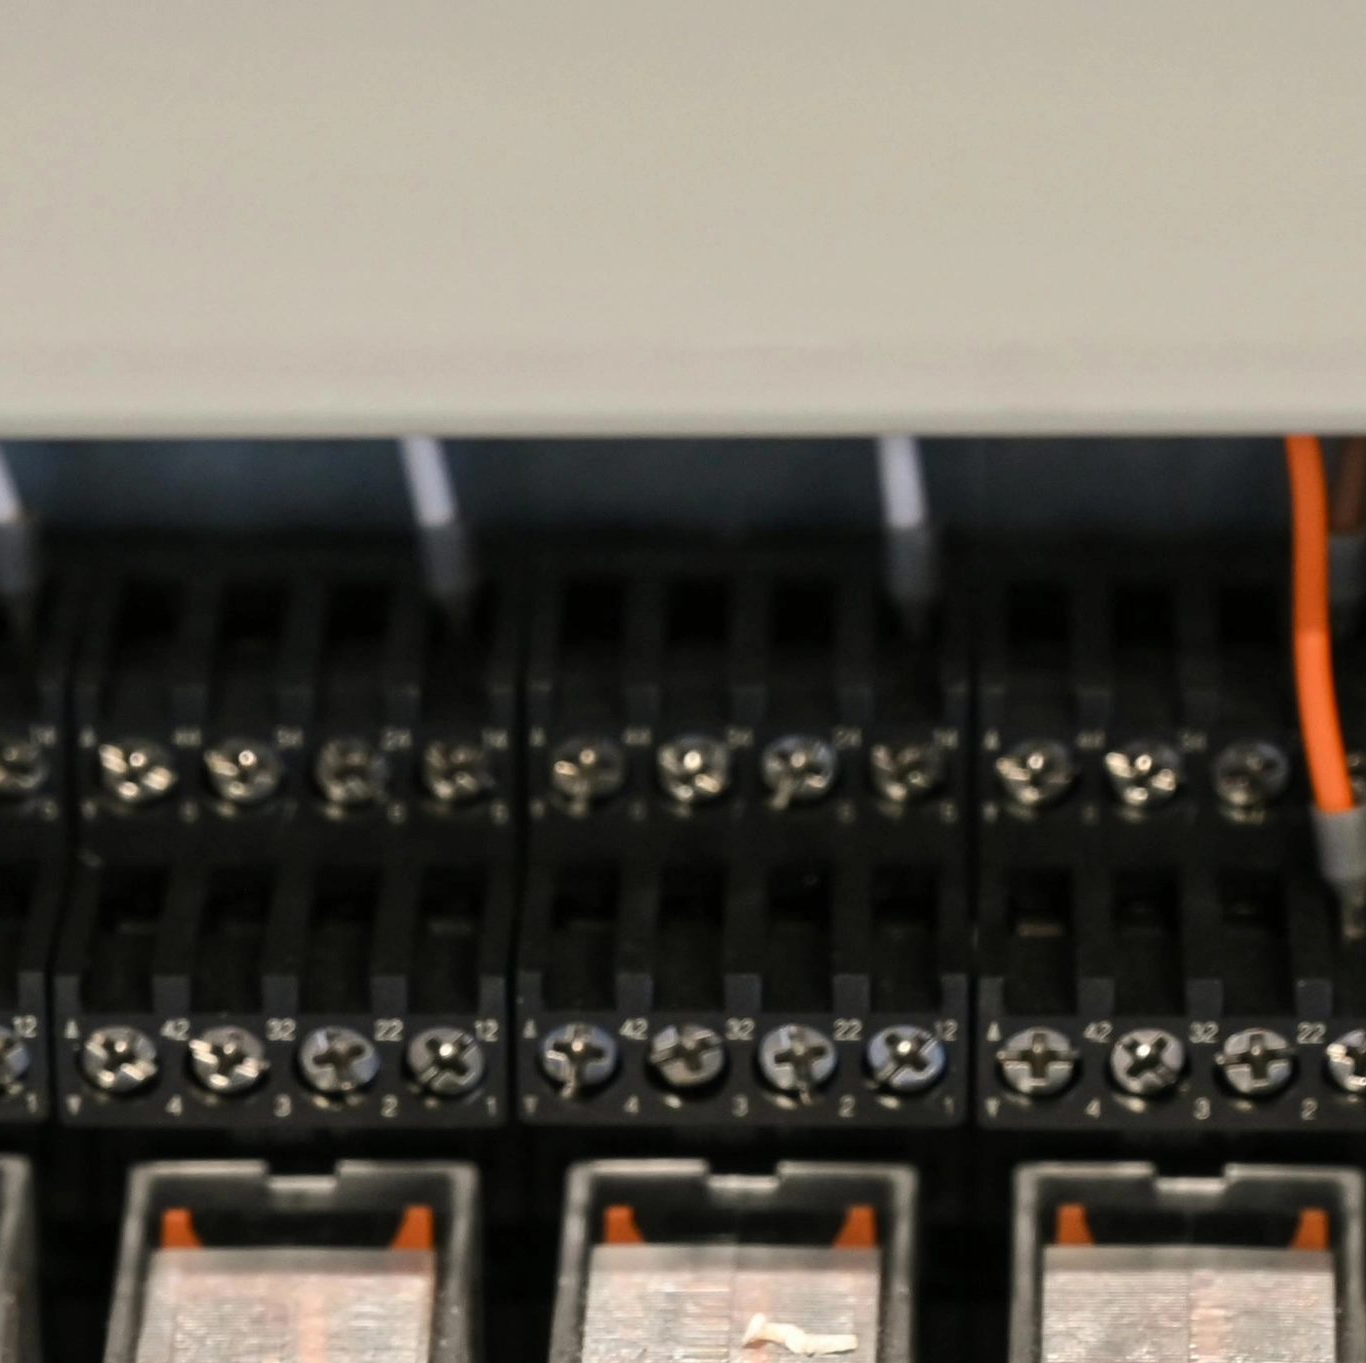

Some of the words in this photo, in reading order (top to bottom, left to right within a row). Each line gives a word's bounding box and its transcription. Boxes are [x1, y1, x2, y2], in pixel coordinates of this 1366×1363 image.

[621, 1018, 648, 1041] 42
[728, 1018, 754, 1041] 32
[835, 1018, 862, 1041] 22
[936, 1019, 958, 1042] 12
[1085, 1021, 1112, 1043] 42
[1191, 1022, 1218, 1044] 32
[1297, 1022, 1326, 1044] 22
[624, 1095, 639, 1116] 4
[735, 1095, 748, 1117] 3
[839, 1094, 855, 1118] 2
[1086, 1099, 1100, 1120] 4
[1196, 1098, 1210, 1120] 3
[1301, 1097, 1317, 1120] 2
